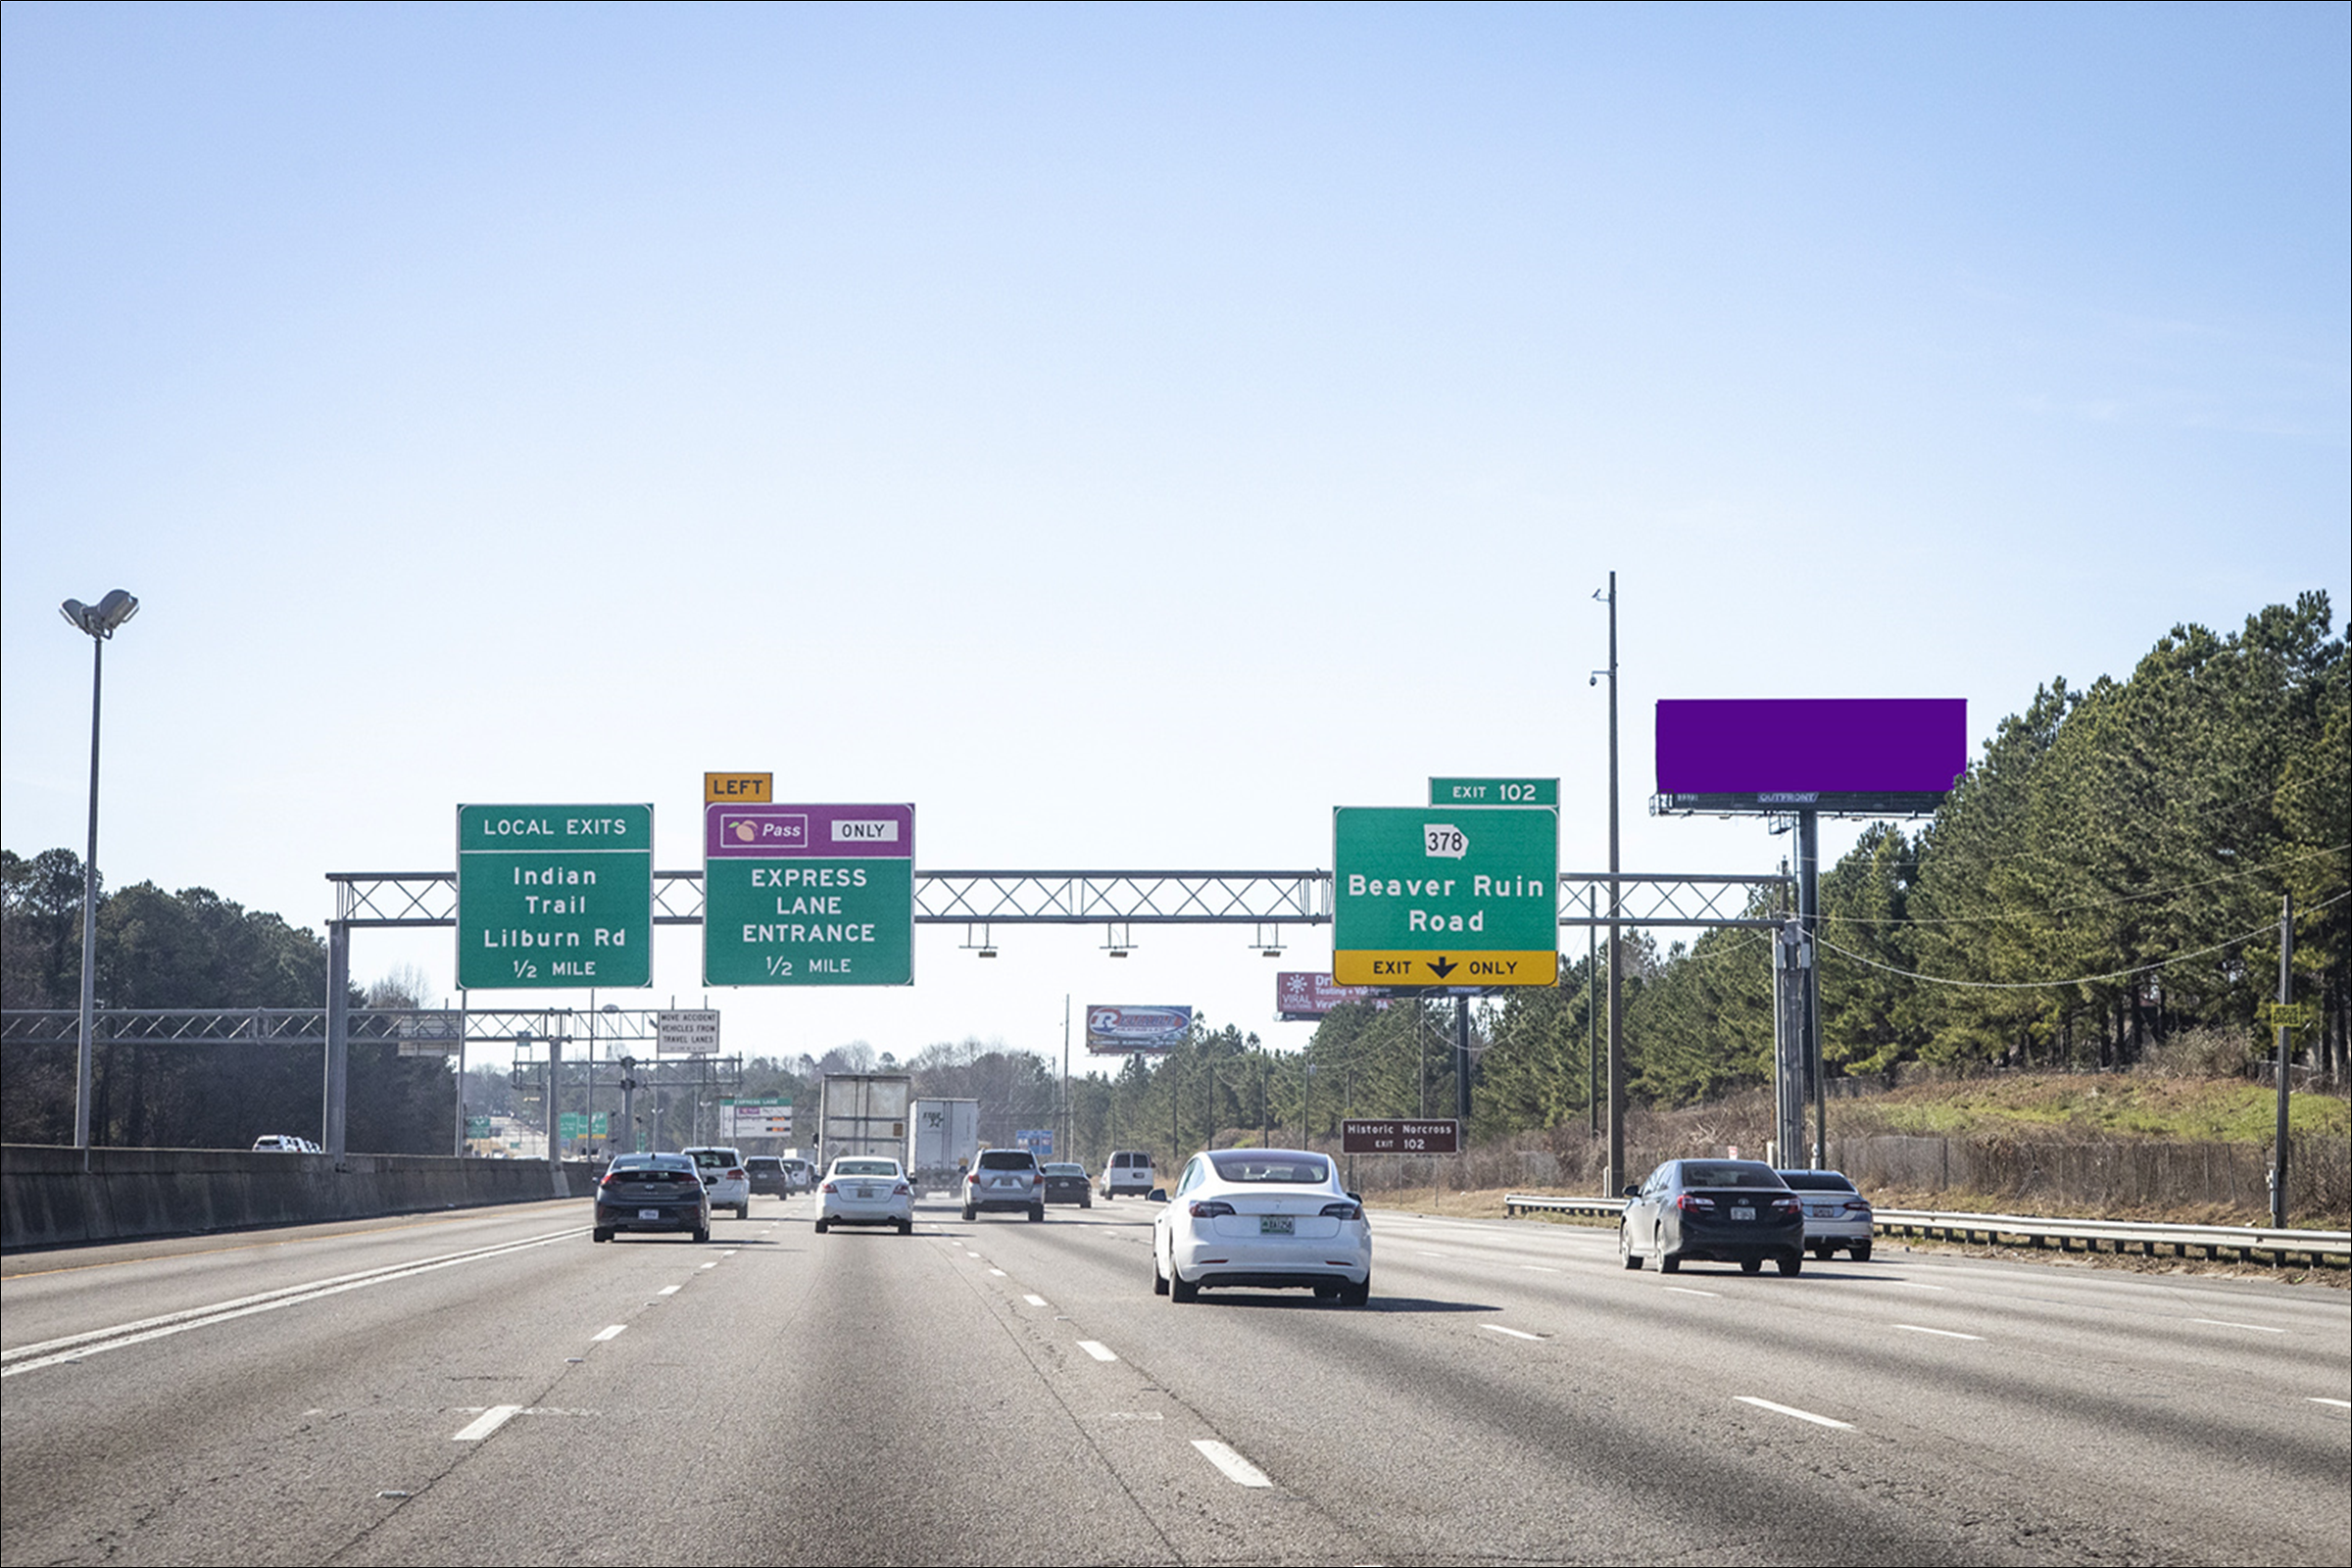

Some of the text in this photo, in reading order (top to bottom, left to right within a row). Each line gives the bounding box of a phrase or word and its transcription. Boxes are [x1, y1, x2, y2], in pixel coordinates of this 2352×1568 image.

[713, 779, 762, 795] LEFT
[1452, 784, 1536, 801] EXIT 102
[484, 819, 627, 835] LOCAL EXITS
[762, 823, 801, 837] Pass
[842, 823, 885, 838] ONLY
[1428, 832, 1462, 851] 378
[514, 867, 596, 885] Indian
[752, 869, 866, 887] EXPRESS
[1348, 874, 1544, 897] Beaver Ruin
[525, 896, 585, 913] Trail
[777, 897, 841, 914] LANE
[1409, 910, 1484, 931] Road
[484, 928, 625, 947] Lilburn Rd
[743, 924, 874, 942] ENTRANCE
[552, 961, 595, 975] MILE
[808, 958, 851, 972] MILE
[1374, 961, 1517, 974] EXIT ONLY
[1282, 994, 1310, 1004] VIRAL
[1315, 987, 1347, 997] Testing
[1348, 1124, 1451, 1134] Historic Norcross
[1403, 1139, 1425, 1150] 102
